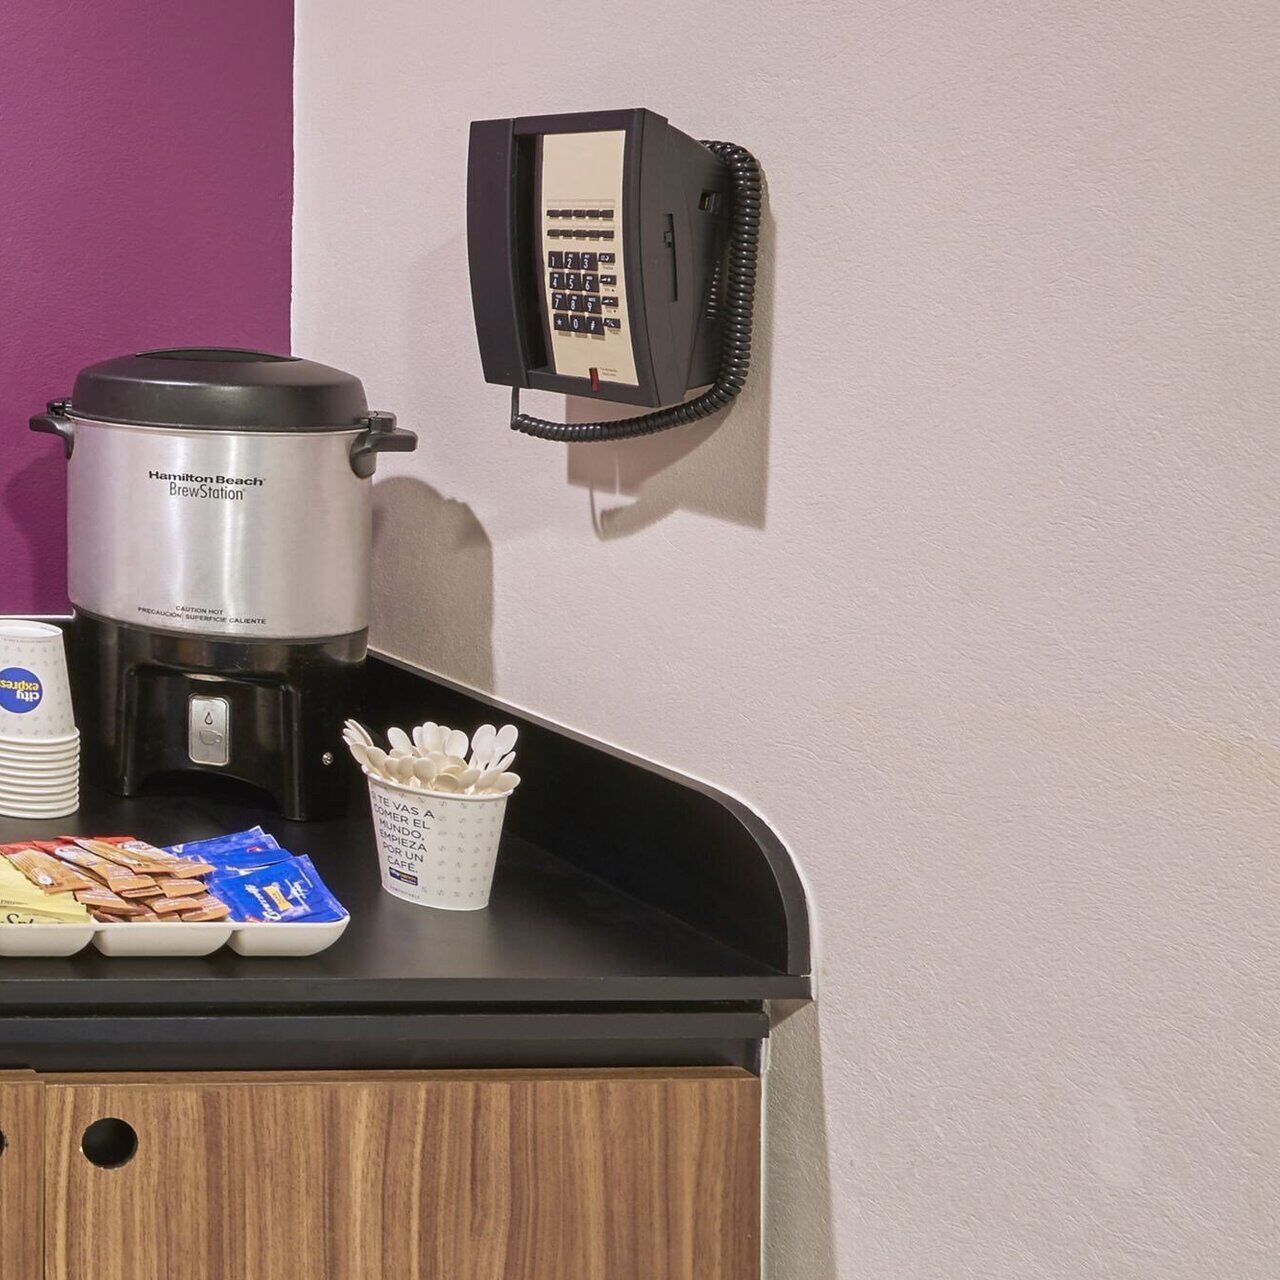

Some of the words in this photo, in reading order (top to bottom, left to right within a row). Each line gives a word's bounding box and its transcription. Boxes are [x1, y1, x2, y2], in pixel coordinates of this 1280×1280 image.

[148, 470, 214, 483] Hamilton
[215, 475, 264, 486] Beach
[169, 481, 243, 500] BrewStation
[175, 605, 207, 614] CAUTION
[185, 613, 227, 623] SUPERFICIE
[228, 617, 267, 625] CALIENTE
[16, 689, 40, 702] city
[374, 803, 409, 826] COMER
[413, 819, 431, 830] EL
[378, 794, 390, 808] TE
[393, 802, 420, 816] VAS
[424, 810, 436, 820] A
[379, 817, 425, 842] MUNDO,
[380, 829, 428, 853] EMPIEZA
[383, 841, 403, 858] POR
[405, 850, 424, 863] UN
